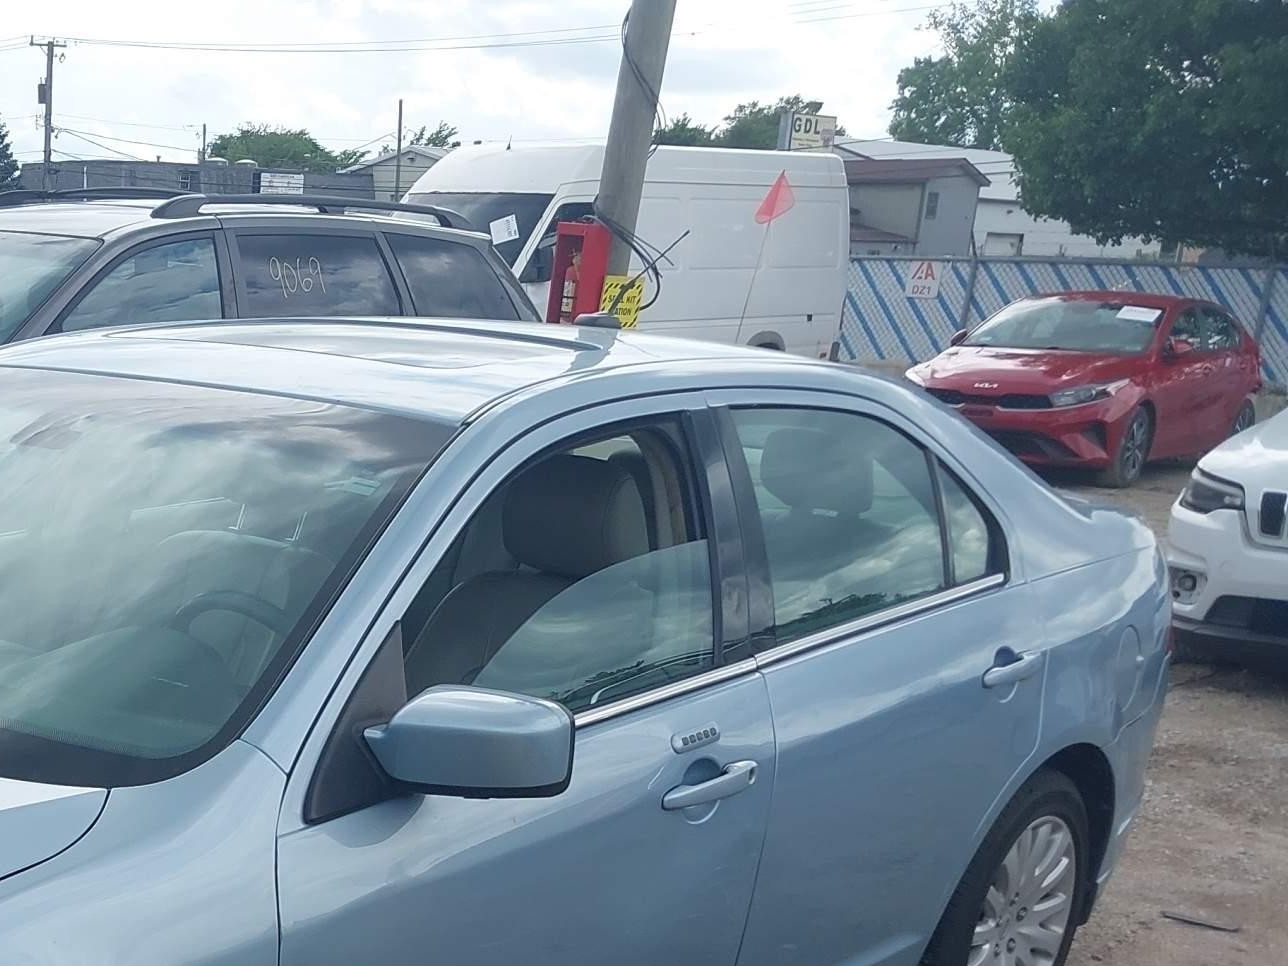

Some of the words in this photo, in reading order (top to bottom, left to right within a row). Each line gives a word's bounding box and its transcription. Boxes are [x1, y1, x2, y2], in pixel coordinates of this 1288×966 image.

[793, 117, 820, 135] GDL
[269, 256, 326, 299] 9069
[625, 295, 637, 304] KIT
[614, 307, 632, 316] ATION
